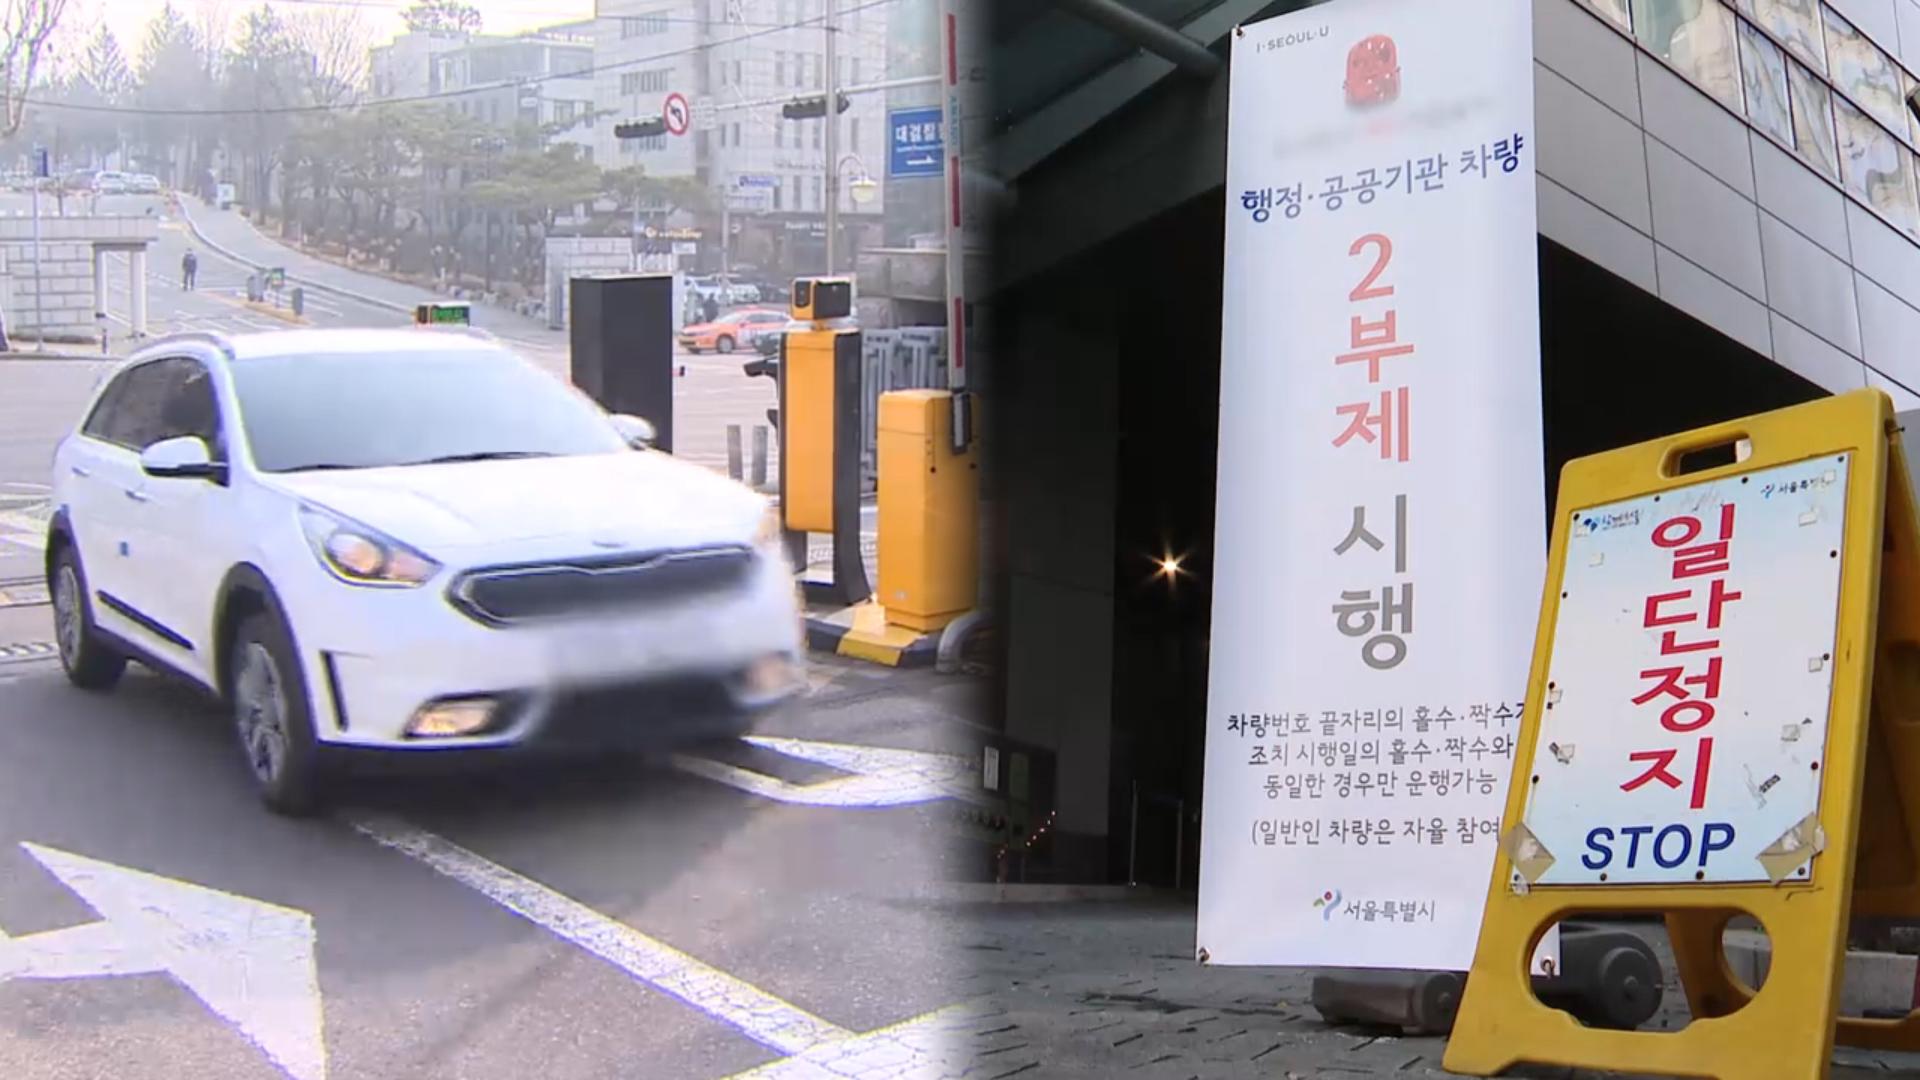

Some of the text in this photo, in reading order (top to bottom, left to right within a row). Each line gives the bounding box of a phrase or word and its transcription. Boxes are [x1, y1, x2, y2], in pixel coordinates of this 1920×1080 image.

[1241, 133, 1525, 224] 행정·공공기관 차량
[1331, 233, 1415, 671] 2부제 시행
[1620, 503, 1742, 809] 일단정지
[1227, 712, 1312, 738] 차량번호
[1319, 707, 1404, 734] 끝자리의
[1248, 734, 1514, 767] 조치 시행일의 홀수·짝수와
[1263, 767, 1498, 799] 동일한 경우만 운행가능
[1250, 819, 1321, 847] (일반인
[1328, 818, 1396, 846] 차량은
[1403, 817, 1449, 845] 자율
[1582, 822, 1736, 871] STOP
[1343, 898, 1436, 923] 서울특별시
